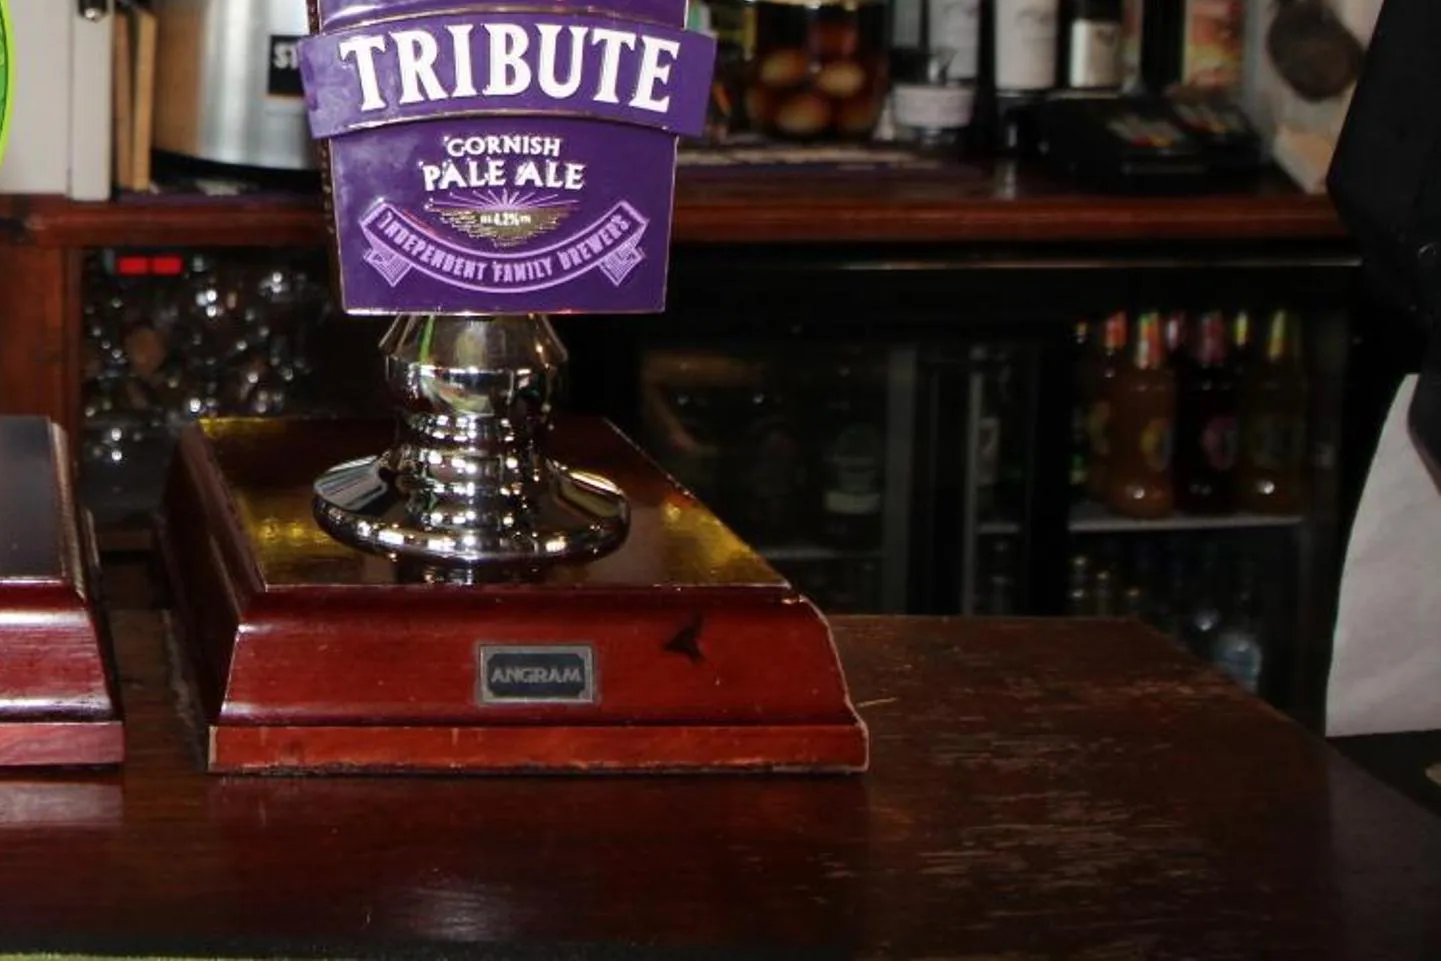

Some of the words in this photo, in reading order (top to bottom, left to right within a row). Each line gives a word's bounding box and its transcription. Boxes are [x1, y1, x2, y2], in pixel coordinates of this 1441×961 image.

[340, 22, 682, 114] TRIBUTE
[445, 135, 562, 158] CORNISH
[421, 159, 507, 192] PALE
[514, 159, 587, 191] ALE
[378, 210, 487, 282] INDEPENDENT
[490, 258, 554, 284] FAMILY
[557, 212, 632, 271] BREWERS
[490, 666, 582, 684] ANGRAM
